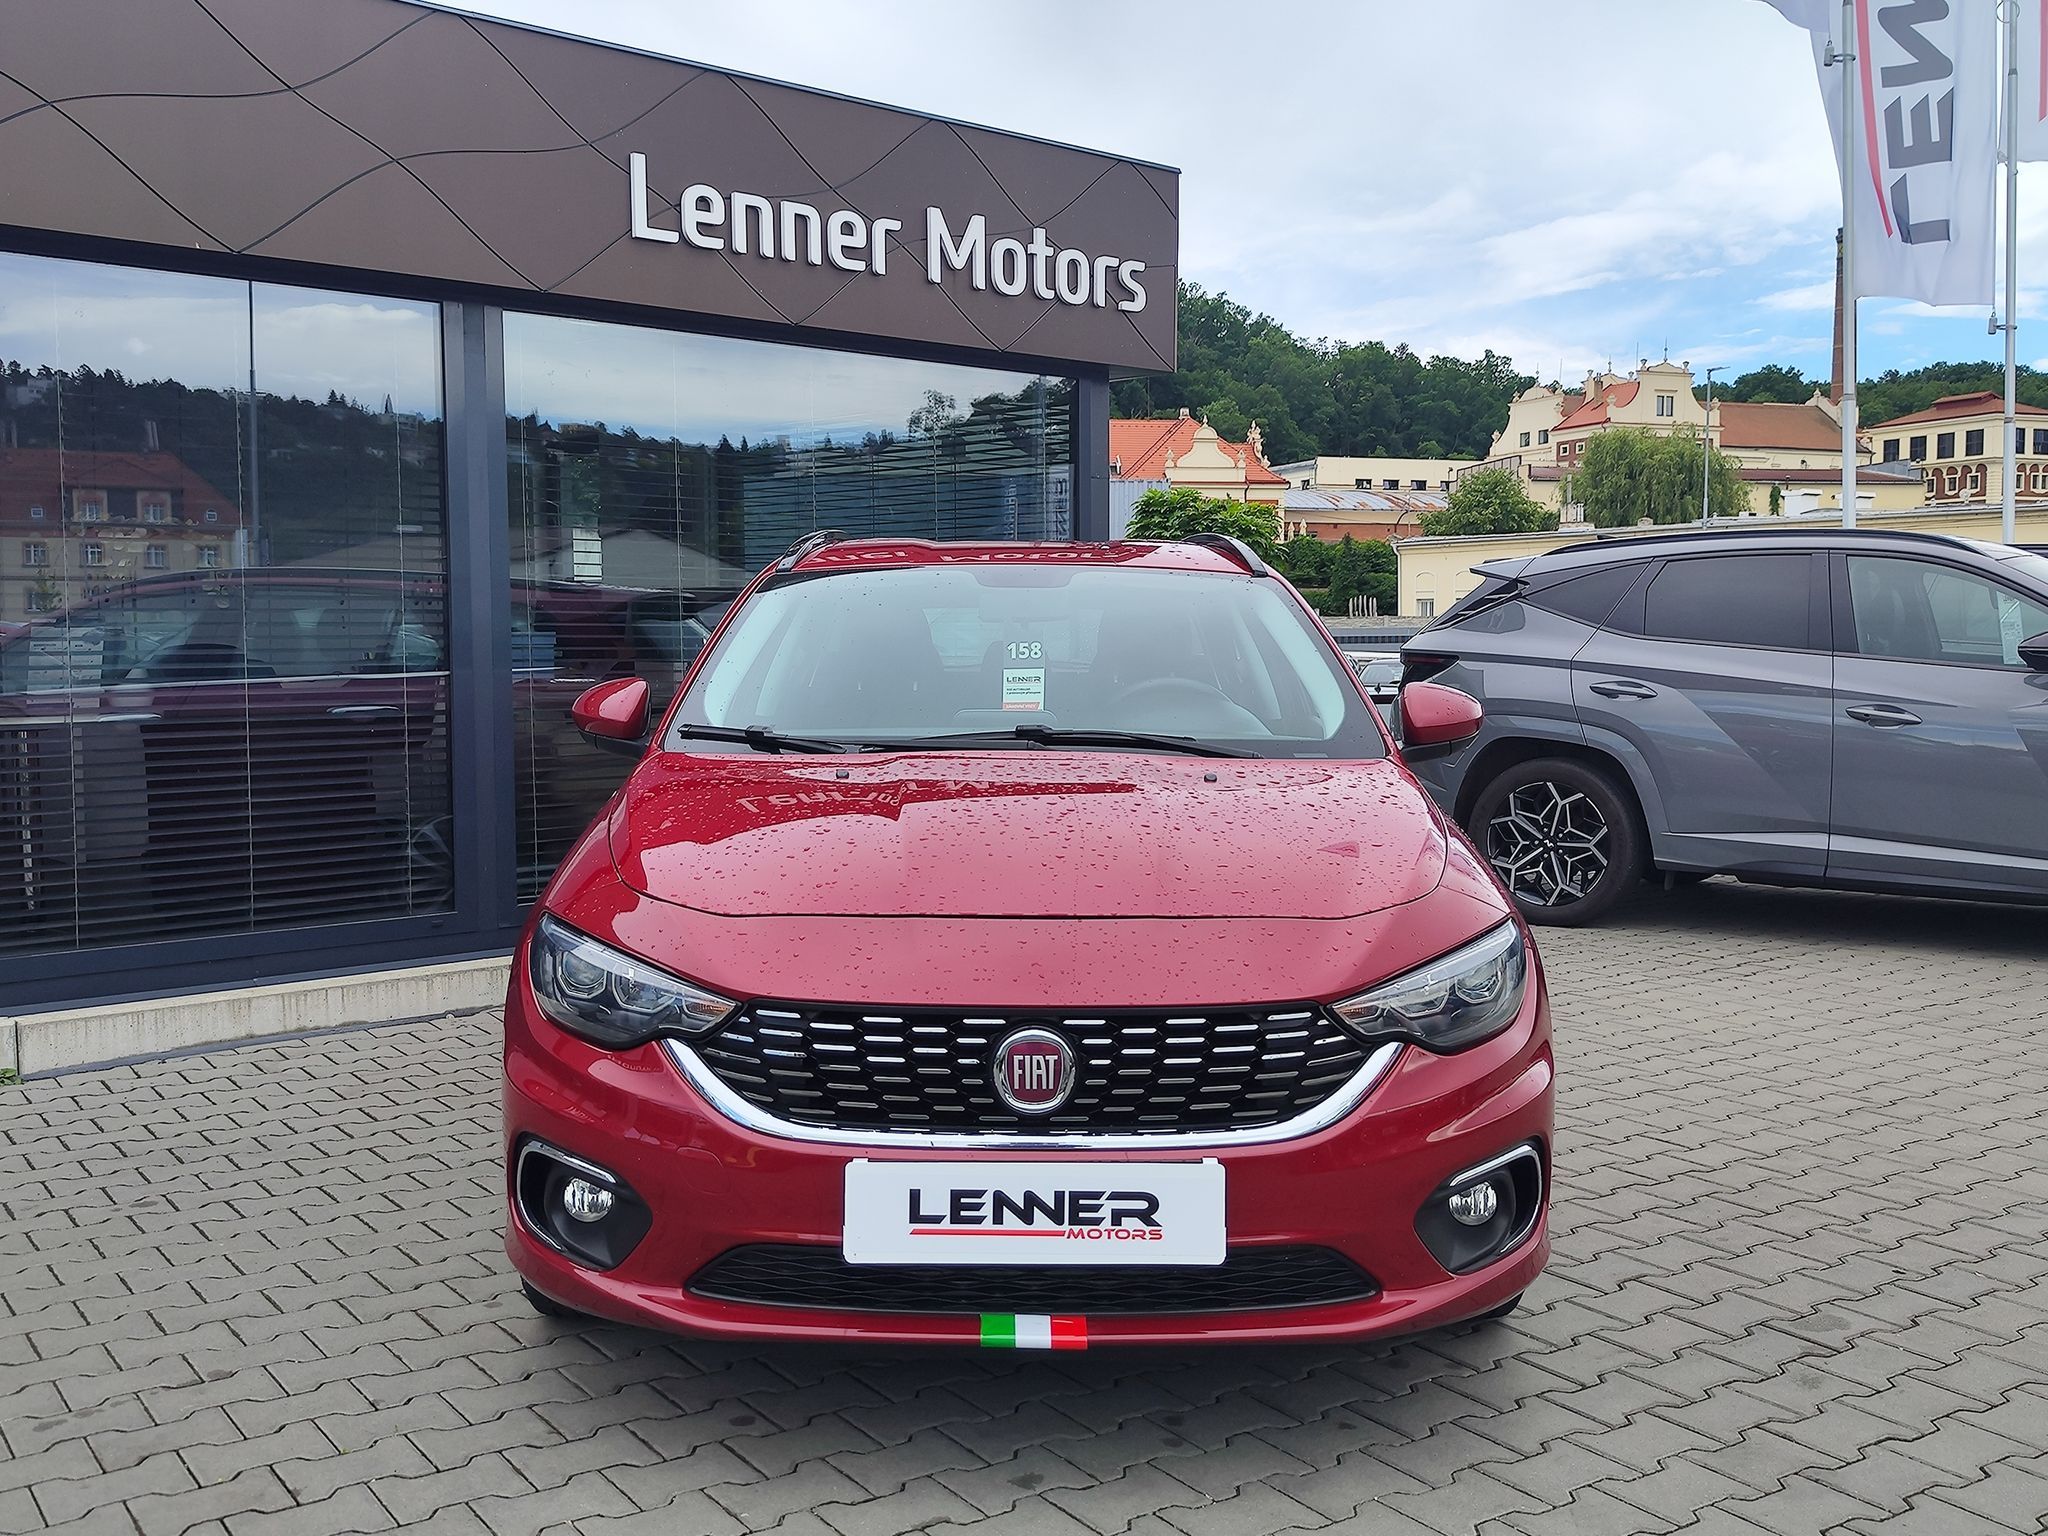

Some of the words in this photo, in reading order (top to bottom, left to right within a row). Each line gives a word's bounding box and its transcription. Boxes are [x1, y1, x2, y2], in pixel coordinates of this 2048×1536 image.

[629, 151, 902, 277] Lenner
[926, 205, 1148, 312] Motors
[1007, 641, 1043, 660] 158
[1013, 1054, 1059, 1091] FIAT
[908, 1188, 1163, 1228] LENNER
[1066, 1227, 1164, 1241] MOTORS
